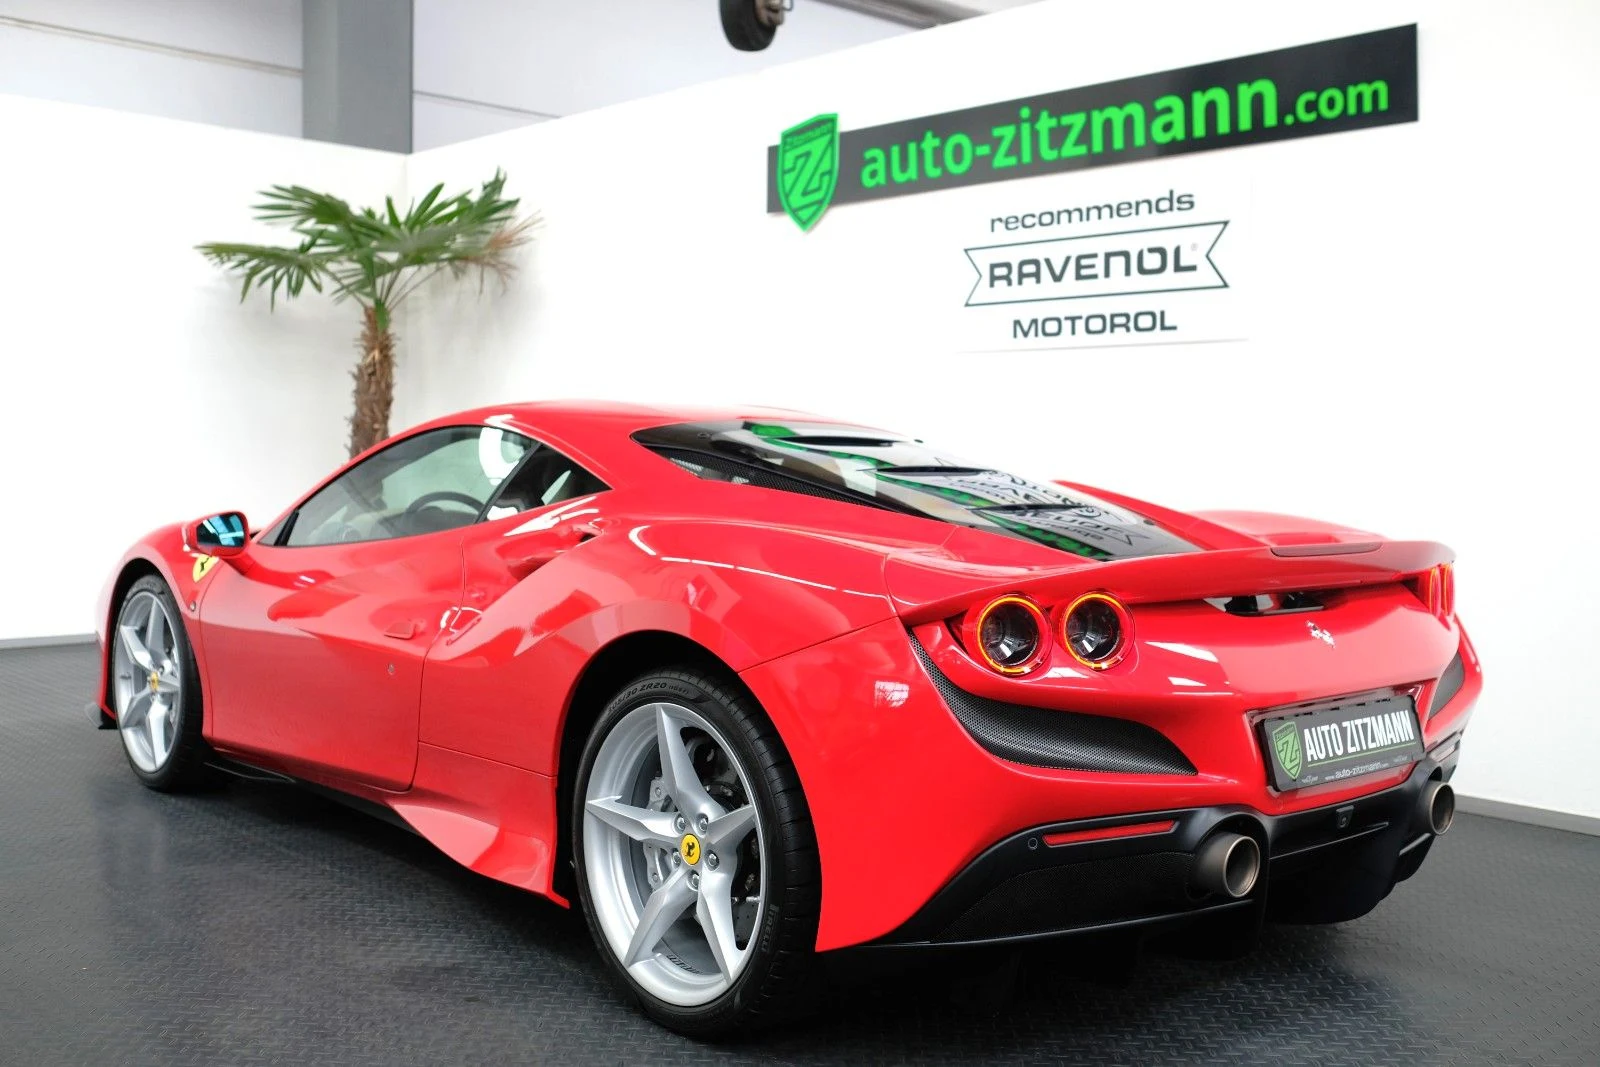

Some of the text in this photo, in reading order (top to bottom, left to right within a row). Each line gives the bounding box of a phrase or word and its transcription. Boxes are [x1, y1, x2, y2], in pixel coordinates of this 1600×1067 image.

[860, 77, 1389, 188] auto-zitzmann.com
[990, 189, 1195, 232] recommends
[988, 245, 1198, 288] RAVENOL
[1012, 310, 1178, 338] MOTOROL
[1303, 723, 1344, 762] AUTO
[1342, 710, 1415, 754] ZITZMANN
